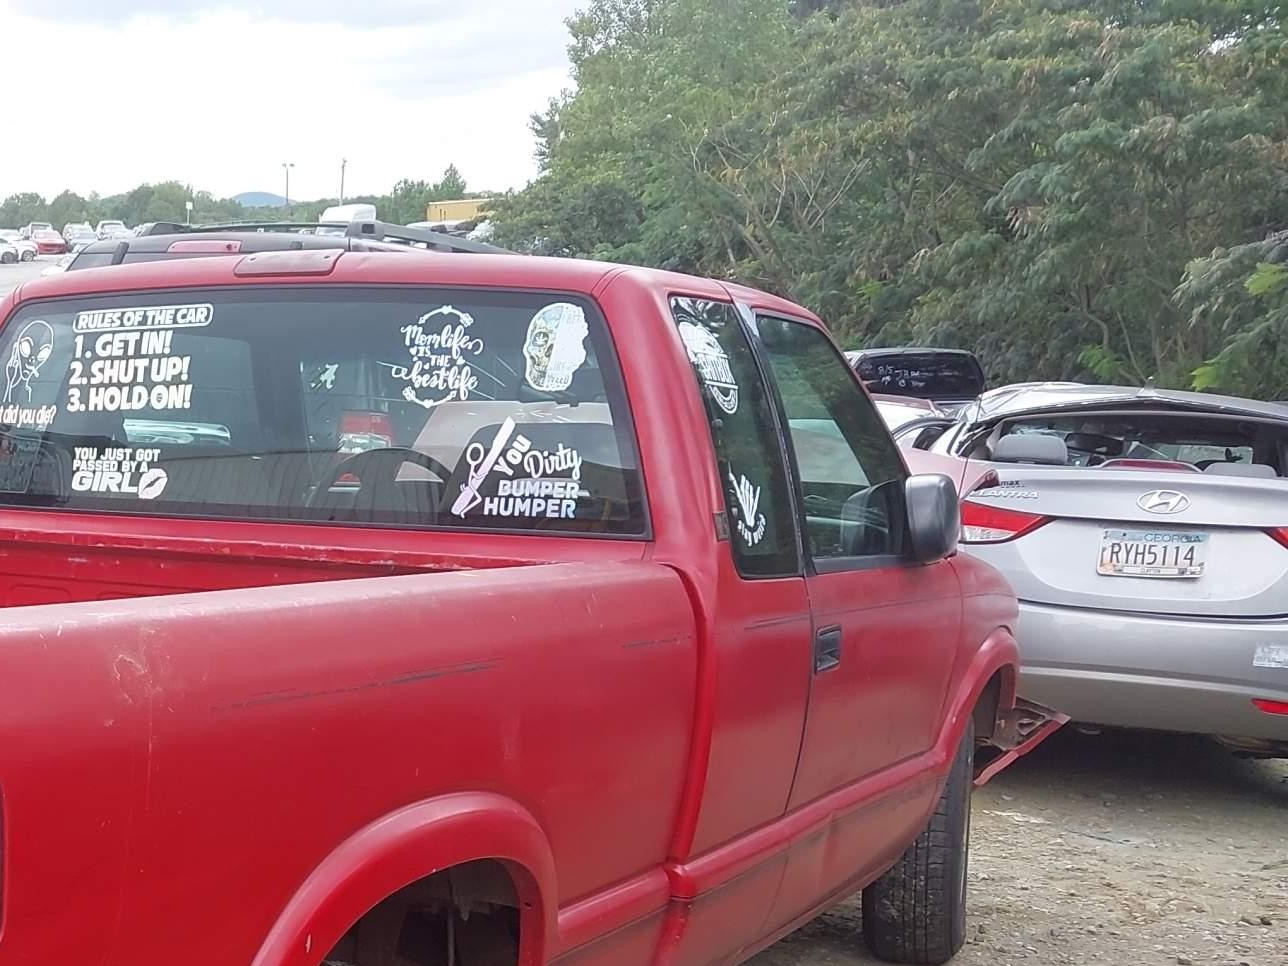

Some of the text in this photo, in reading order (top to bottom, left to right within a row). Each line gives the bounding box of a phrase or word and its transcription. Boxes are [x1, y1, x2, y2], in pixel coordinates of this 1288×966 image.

[77, 307, 208, 329] RULES OF THE CAR
[74, 330, 173, 358] 1. GET IN!
[417, 346, 431, 357] IS
[69, 356, 191, 385] 2. SHUT UP!
[430, 355, 451, 367] THE
[67, 384, 193, 412] 3. HOLD ON!
[3, 404, 20, 423] did
[16, 409, 36, 428] you
[74, 447, 161, 462] YOU JUST GOT
[523, 443, 582, 481] Dirty
[72, 460, 149, 472] PASSED BY A
[71, 471, 138, 492] GIRL
[498, 479, 580, 499] BUMPER
[483, 497, 577, 519] HUMPER
[1144, 533, 1202, 543] GEORGIA
[1109, 542, 1195, 567] RYH5114
